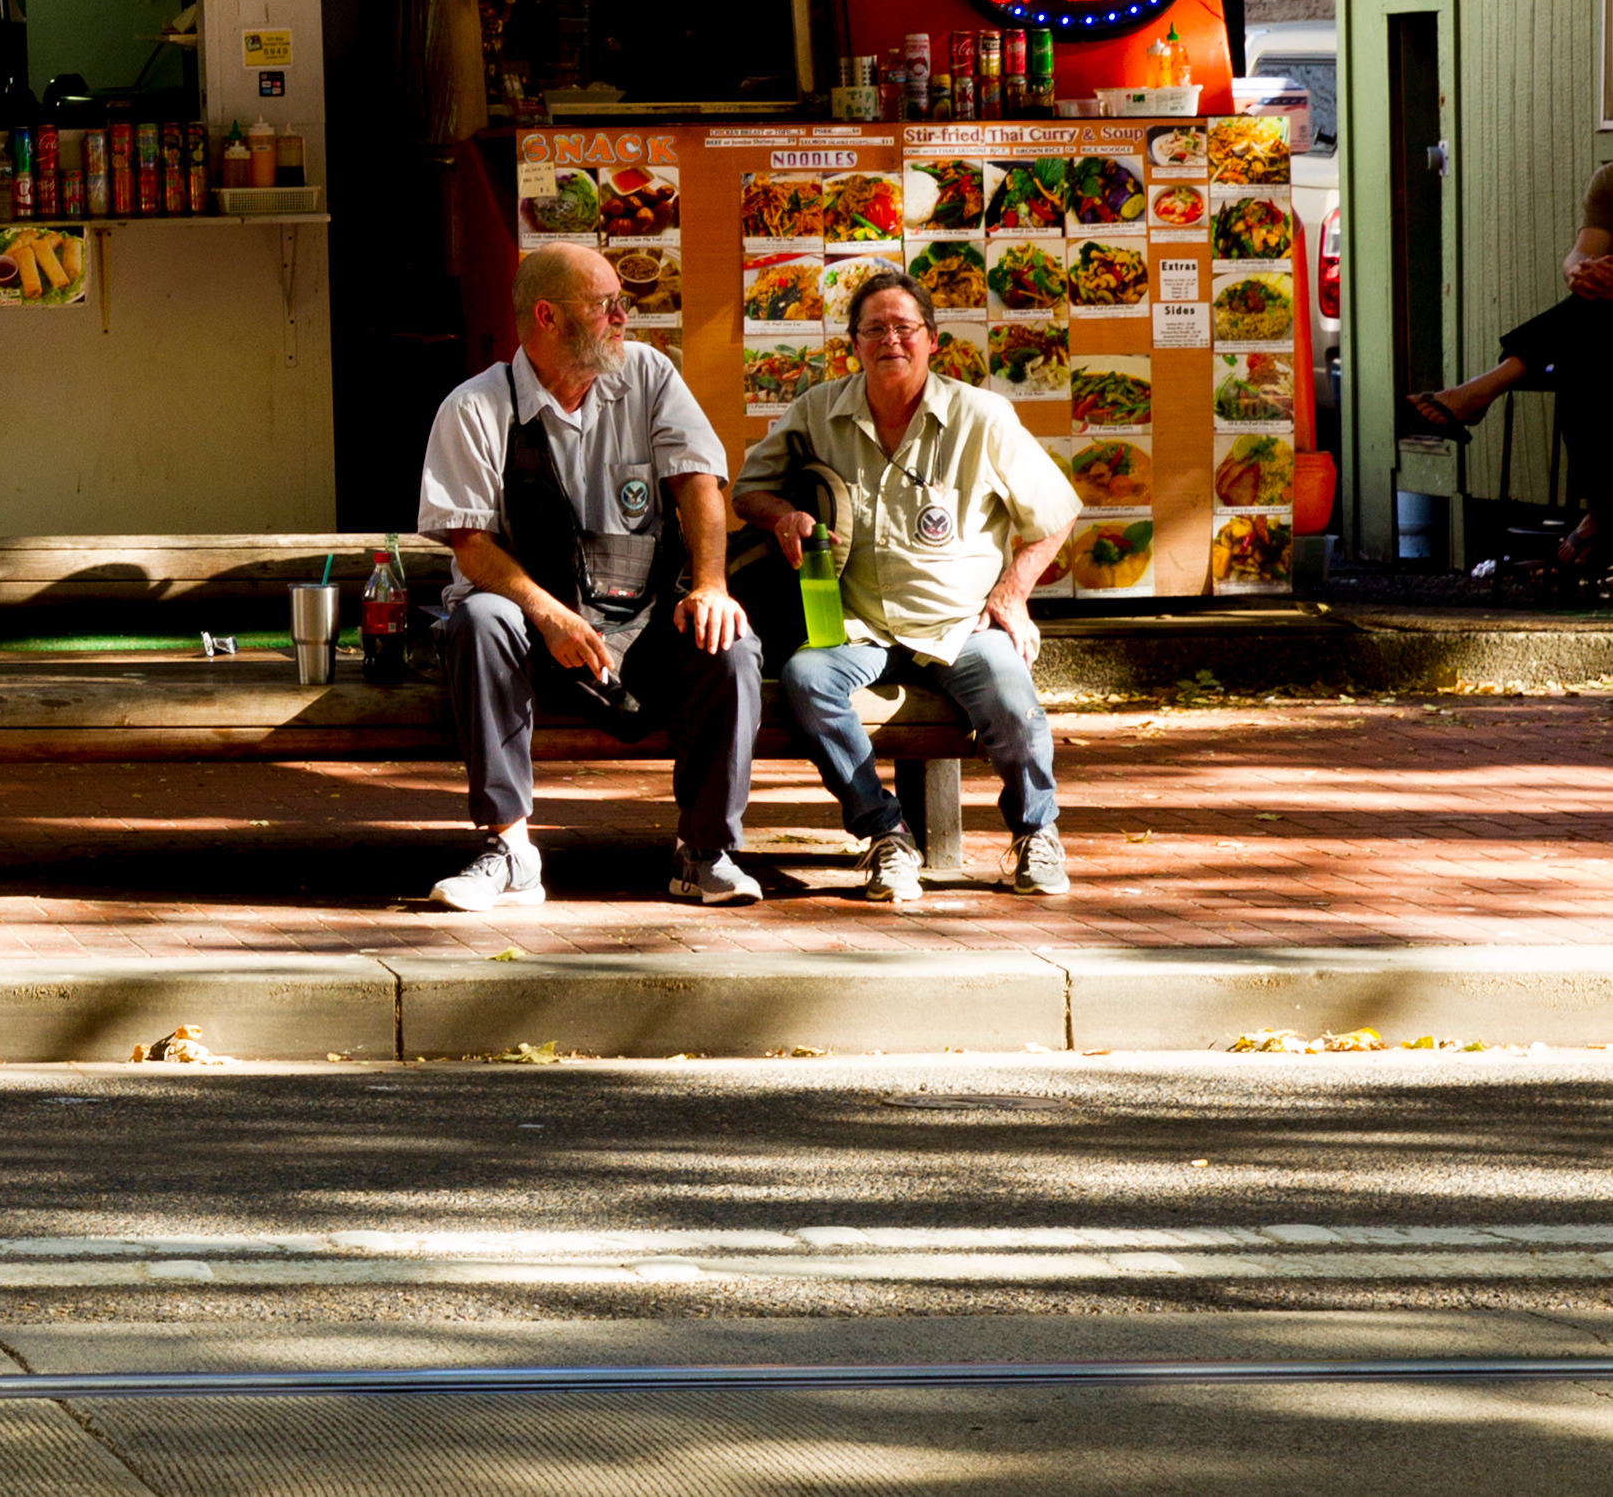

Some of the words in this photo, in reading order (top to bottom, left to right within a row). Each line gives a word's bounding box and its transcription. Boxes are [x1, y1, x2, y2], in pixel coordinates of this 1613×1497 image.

[263, 47, 288, 55] 6949
[905, 126, 985, 145] Stir-fried,
[988, 126, 1024, 142] Thai
[1029, 126, 1078, 145] Curry
[1082, 126, 1097, 141] &
[1100, 125, 1144, 145] Soup
[522, 133, 678, 164] SNACK
[773, 152, 855, 166] NOODLES
[1161, 261, 1196, 271] Extras
[1164, 305, 1196, 315] Sides
